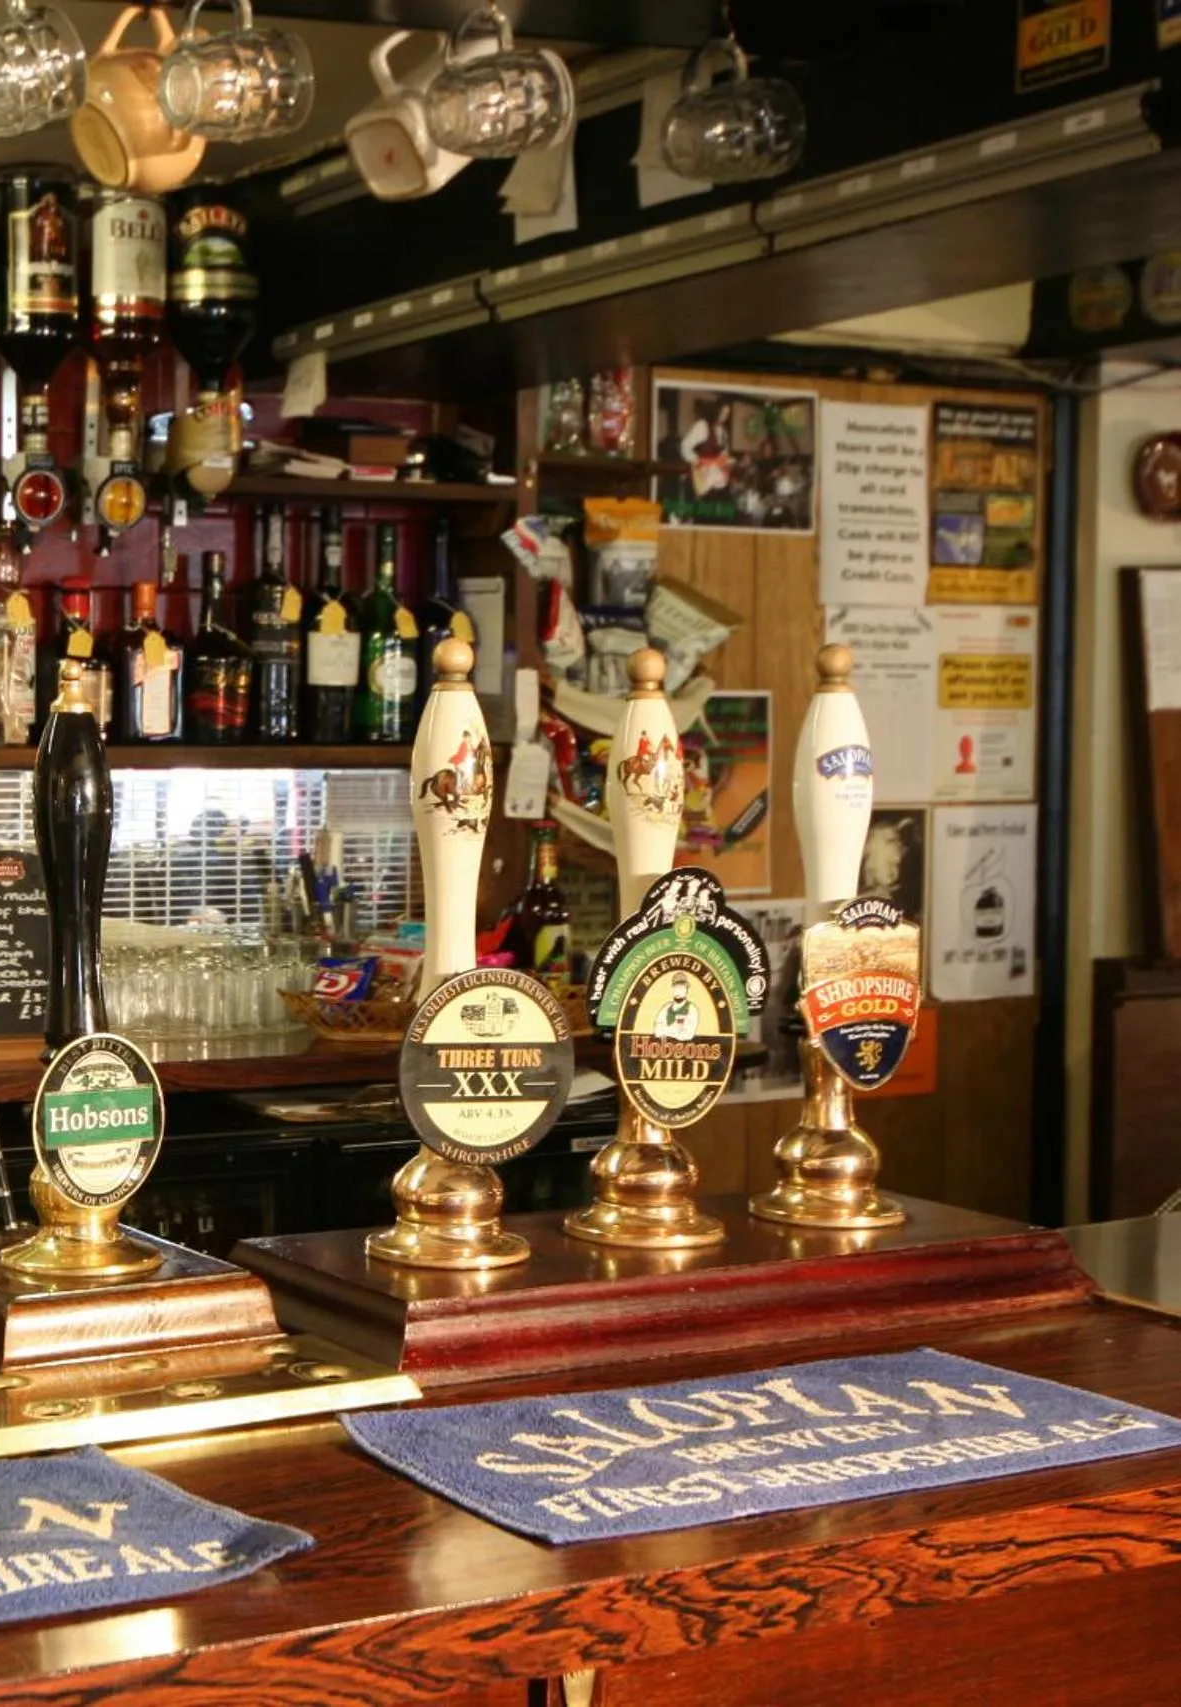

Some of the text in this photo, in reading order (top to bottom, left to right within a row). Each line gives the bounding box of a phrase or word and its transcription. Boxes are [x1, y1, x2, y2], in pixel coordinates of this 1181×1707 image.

[16, 905, 49, 916] the
[842, 900, 899, 925] SALOPIAN
[603, 937, 627, 965] with
[626, 915, 650, 940] real
[641, 955, 719, 991] BREWED BY
[426, 982, 461, 1017] OLDEST
[463, 970, 517, 989] LICENSED
[517, 978, 558, 1018] BREWERY
[815, 975, 914, 1008] SHROPSHIRE
[840, 998, 899, 1017] GOLD
[58, 1041, 88, 1075] BEST
[437, 1048, 543, 1069] THREE TUNS
[629, 1035, 722, 1061] Hobsons
[639, 1058, 710, 1081] MILD
[451, 1071, 524, 1098] XXX
[49, 1103, 149, 1134] Hobsons
[459, 1108, 483, 1119] ABV
[440, 1136, 533, 1164] SHROPSHIRE
[475, 1376, 1027, 1485] SALOPIAN
[535, 1469, 753, 1523] FINEST
